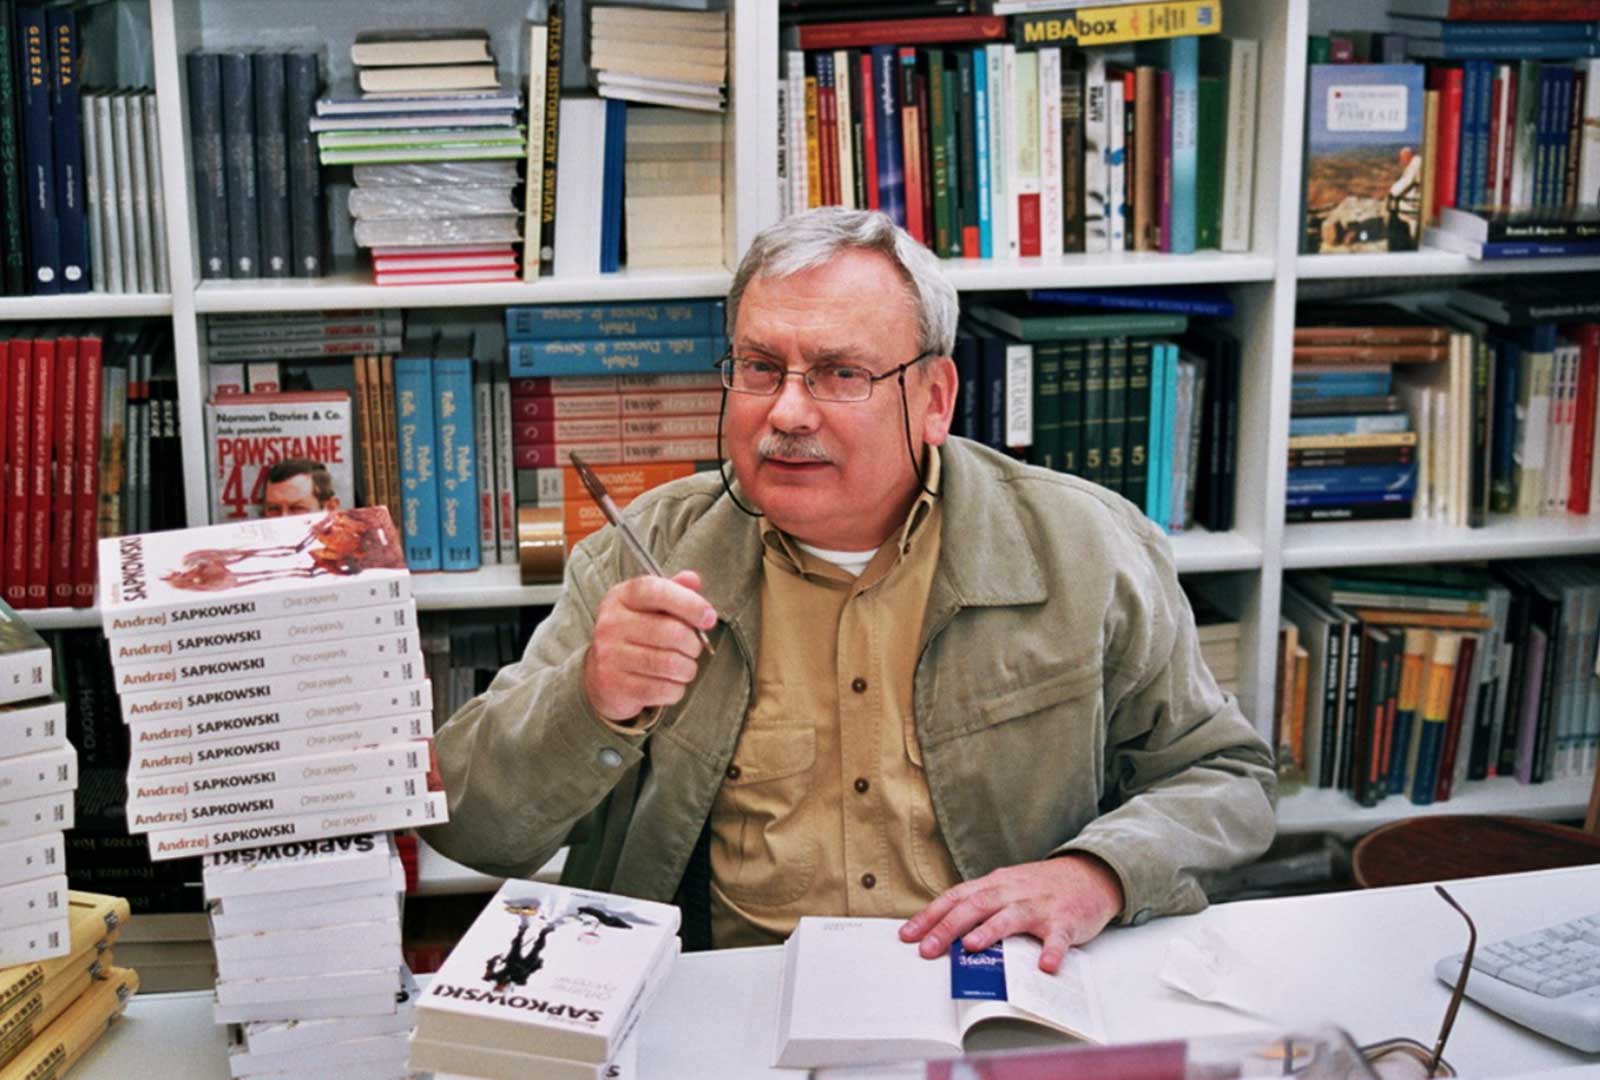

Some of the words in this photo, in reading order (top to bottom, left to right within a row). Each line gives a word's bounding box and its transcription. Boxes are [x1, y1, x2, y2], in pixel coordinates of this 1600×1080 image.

[549, 15, 564, 60] ATLAS
[28, 25, 42, 87] GEJSZA
[58, 25, 72, 86] GEJSZA
[544, 66, 561, 162] HISTORYCZNY
[216, 412, 266, 423] Norman
[269, 411, 308, 422] Davies
[312, 411, 321, 420] &
[325, 410, 342, 419] Co.
[217, 425, 234, 435] Jak
[217, 435, 343, 466] POWSTANIE
[402, 424, 416, 471] Dances
[442, 424, 456, 471] Dances
[1088, 449, 1102, 468] 5
[1109, 447, 1122, 466] 5
[1131, 445, 1145, 466] 5
[405, 497, 419, 536] Songs
[445, 497, 459, 537] Songs
[120, 536, 147, 602] SAPKOWSKI
[112, 612, 167, 629] Andrzej
[171, 602, 256, 622] SAPKOWSKI
[119, 640, 173, 658] Andrzej
[177, 630, 262, 651] SAPKOWSKI
[123, 668, 177, 685] Andrzej
[181, 658, 265, 678] SAPKOWSKI
[130, 697, 184, 714] Andrzej
[187, 685, 271, 707] SAPKOWSKI
[139, 725, 193, 742] Andrzej
[196, 713, 280, 734] SAPKOWSKI
[140, 752, 193, 769] Andrzej
[197, 741, 280, 761] SAPKOWSKI
[136, 782, 189, 798] Andrzej
[193, 771, 276, 791] SAPKOWSKI
[135, 809, 188, 825] Andrzej
[191, 799, 274, 818] SAPKOWSKI
[157, 836, 209, 852] Andrzej
[213, 823, 296, 845] SAPKOWSKI
[213, 834, 375, 866] SAPKOWSKI
[432, 984, 604, 1023] SAPKOWSKI
